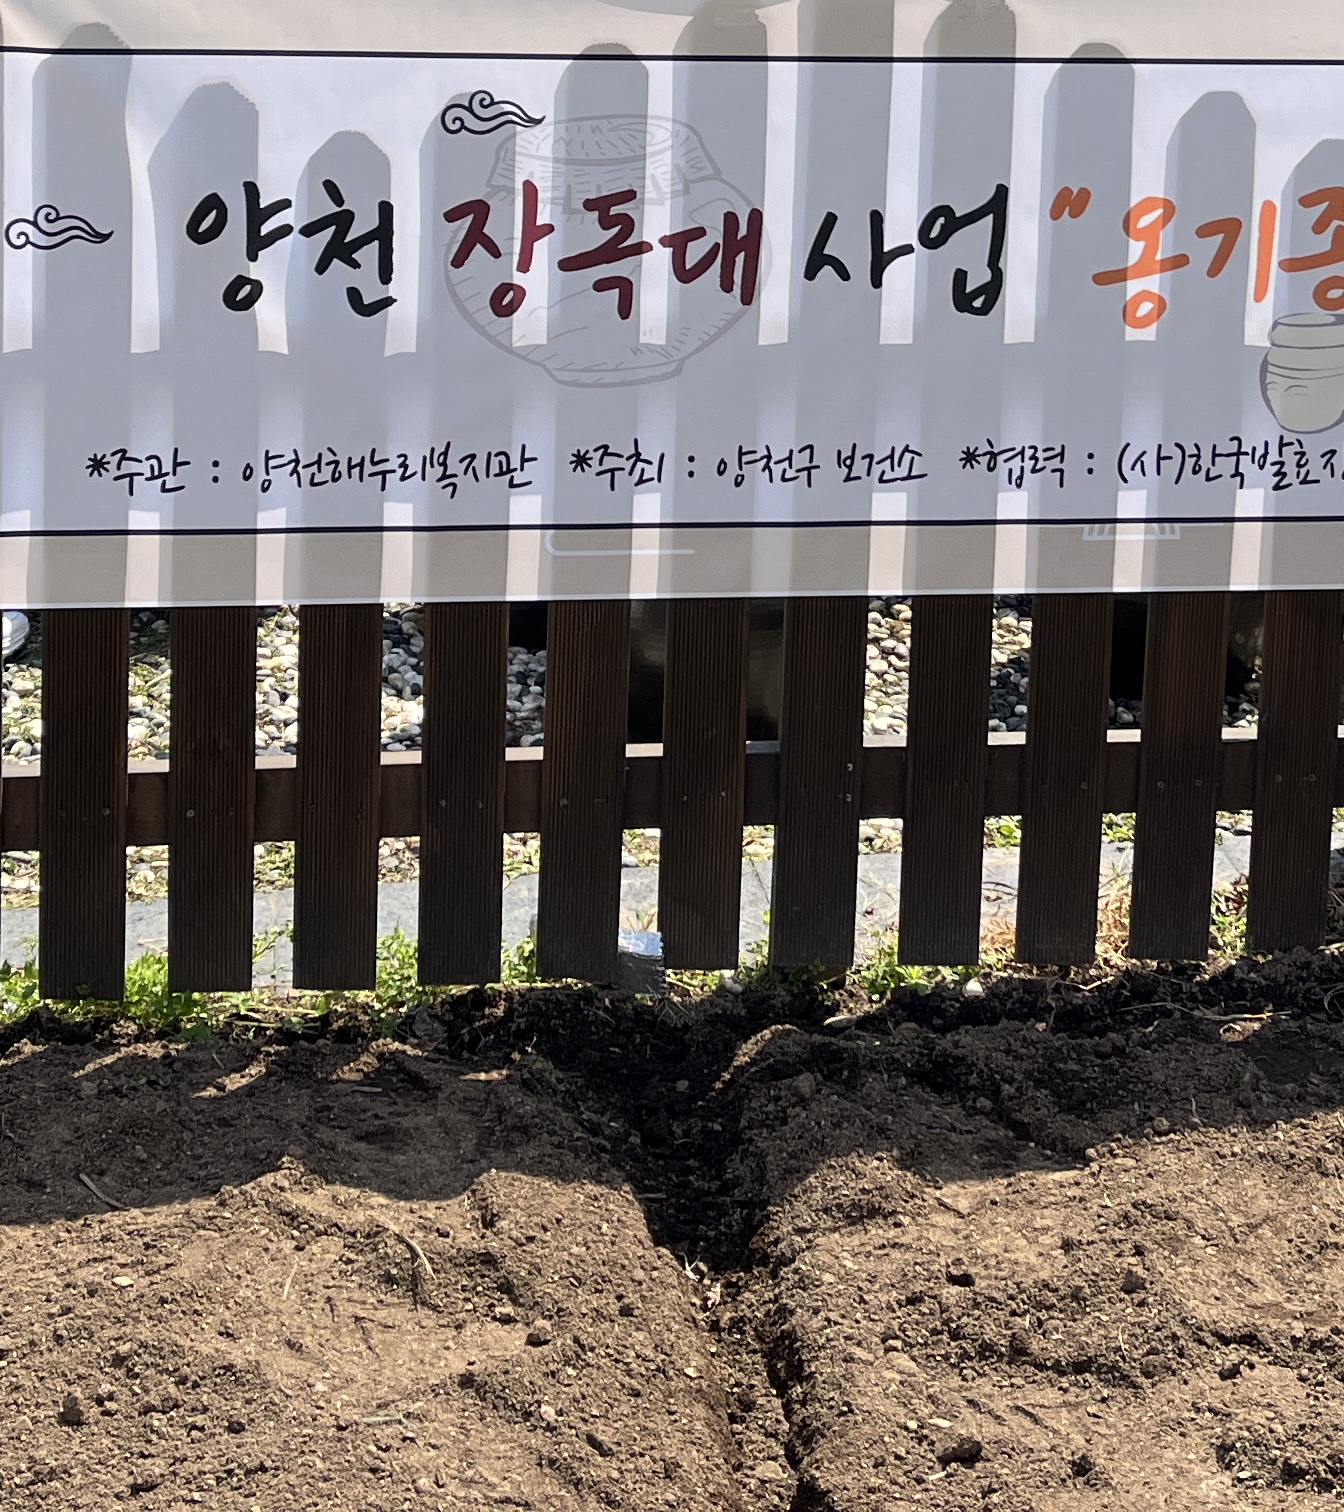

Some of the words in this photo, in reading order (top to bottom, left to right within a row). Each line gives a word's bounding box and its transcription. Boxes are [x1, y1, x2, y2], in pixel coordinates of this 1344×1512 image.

[186, 179, 398, 317] 양천
[443, 179, 763, 321] 장독대
[804, 184, 1009, 317] 사업
[243, 441, 538, 500] 양천해누리복지관
[716, 443, 821, 489] 양천구
[836, 442, 929, 484] 보건소
